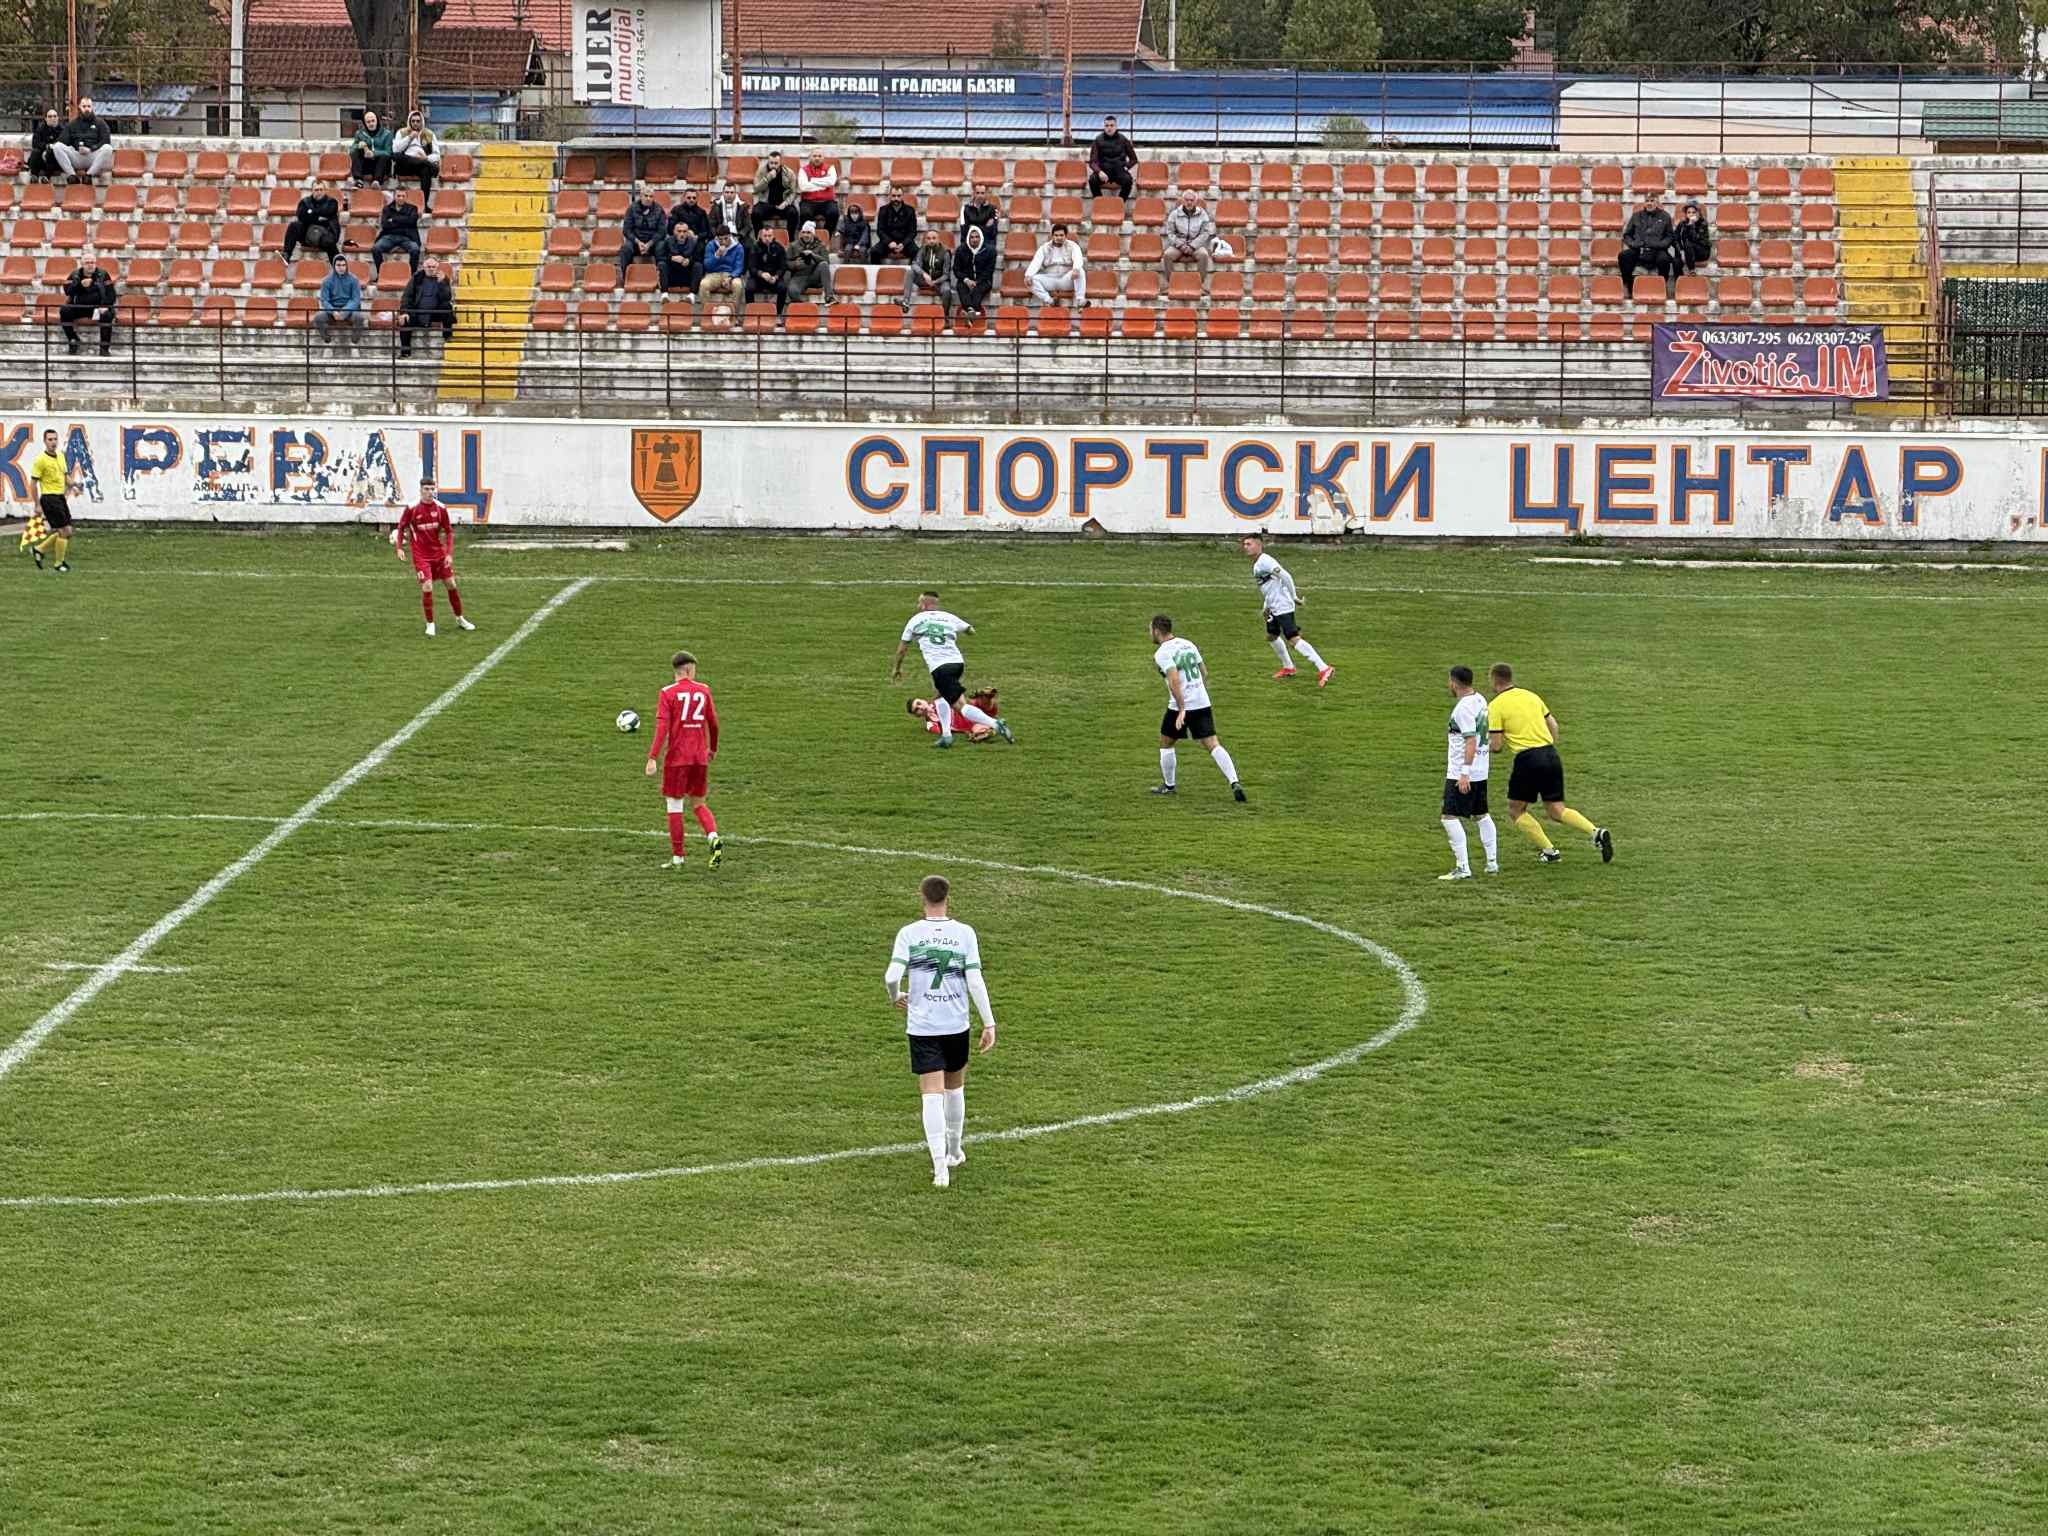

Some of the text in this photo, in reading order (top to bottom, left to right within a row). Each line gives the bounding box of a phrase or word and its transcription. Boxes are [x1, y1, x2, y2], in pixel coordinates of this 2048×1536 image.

[614, 8, 636, 101] mundijal
[722, 75, 781, 92] ЦНТАР
[967, 78, 1016, 93] БАЗЕН
[1702, 330, 1872, 345] 063/307-295 062/8307-295
[845, 434, 1435, 523] СПОРТСКИ
[1508, 442, 1964, 534] ЦЕНТАР
[676, 691, 706, 721] 72
[926, 950, 954, 990] 7
